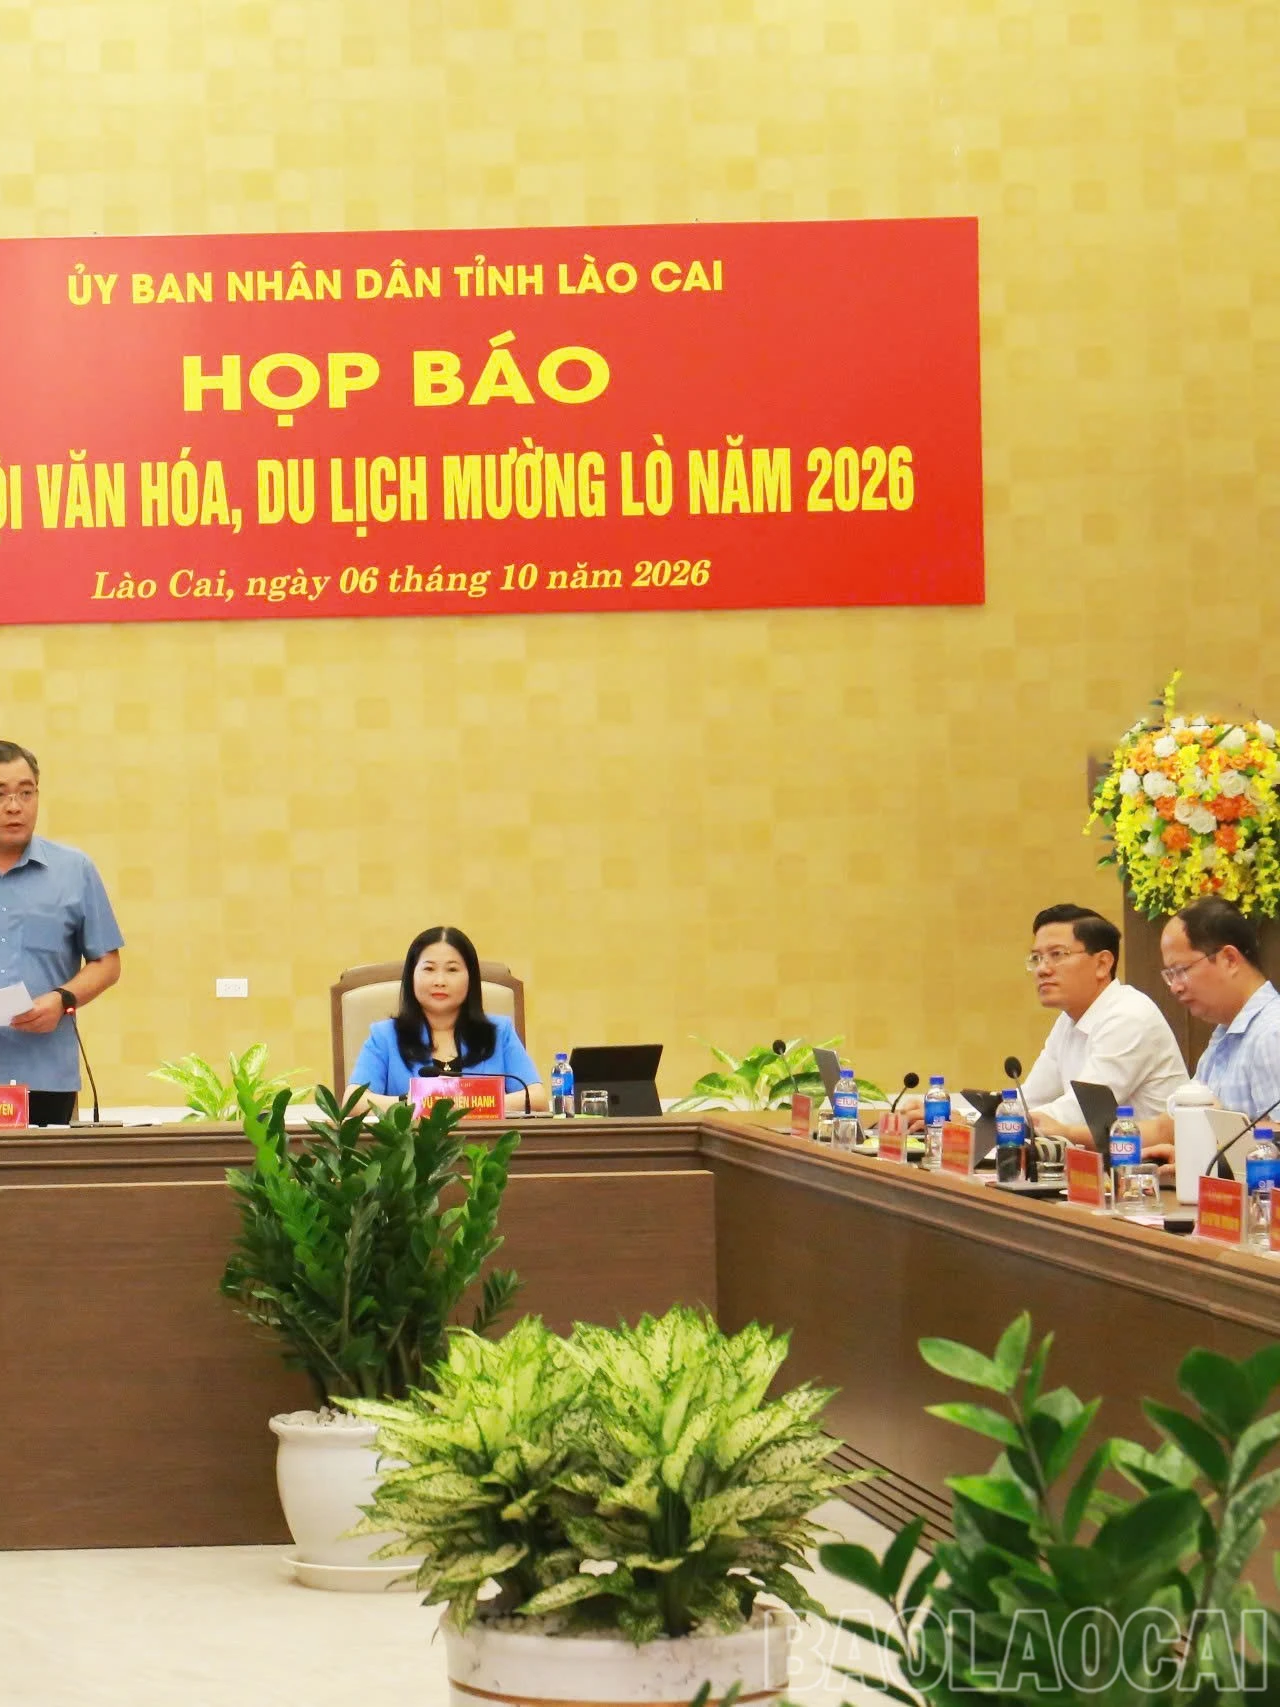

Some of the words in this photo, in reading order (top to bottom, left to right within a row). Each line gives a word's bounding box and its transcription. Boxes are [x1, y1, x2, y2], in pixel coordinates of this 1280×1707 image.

[68, 263, 118, 305] ỦY
[131, 272, 213, 304] BAN
[228, 261, 342, 302] NHÂN
[356, 259, 442, 299] DÂN
[453, 254, 544, 297] TỈNH
[558, 253, 638, 295] LÀO
[650, 260, 723, 293] CAI
[182, 352, 380, 427] HỌP
[413, 330, 610, 407] BÁO
[36, 448, 126, 530] VĂN
[140, 446, 243, 534] HÓA,
[257, 459, 316, 525] DU
[330, 455, 428, 538] LỊCH
[442, 436, 606, 521] MƯỜNG
[620, 433, 674, 517] LÒ
[688, 434, 792, 515] NĂM
[806, 446, 915, 513] 2026
[91, 571, 157, 600] Lào
[168, 569, 235, 603] Cai,
[244, 568, 332, 603] ngày
[339, 566, 380, 595] 06
[388, 565, 491, 598] tháng
[499, 563, 539, 591] 10
[545, 561, 623, 590] năm
[631, 559, 712, 588] 2026
